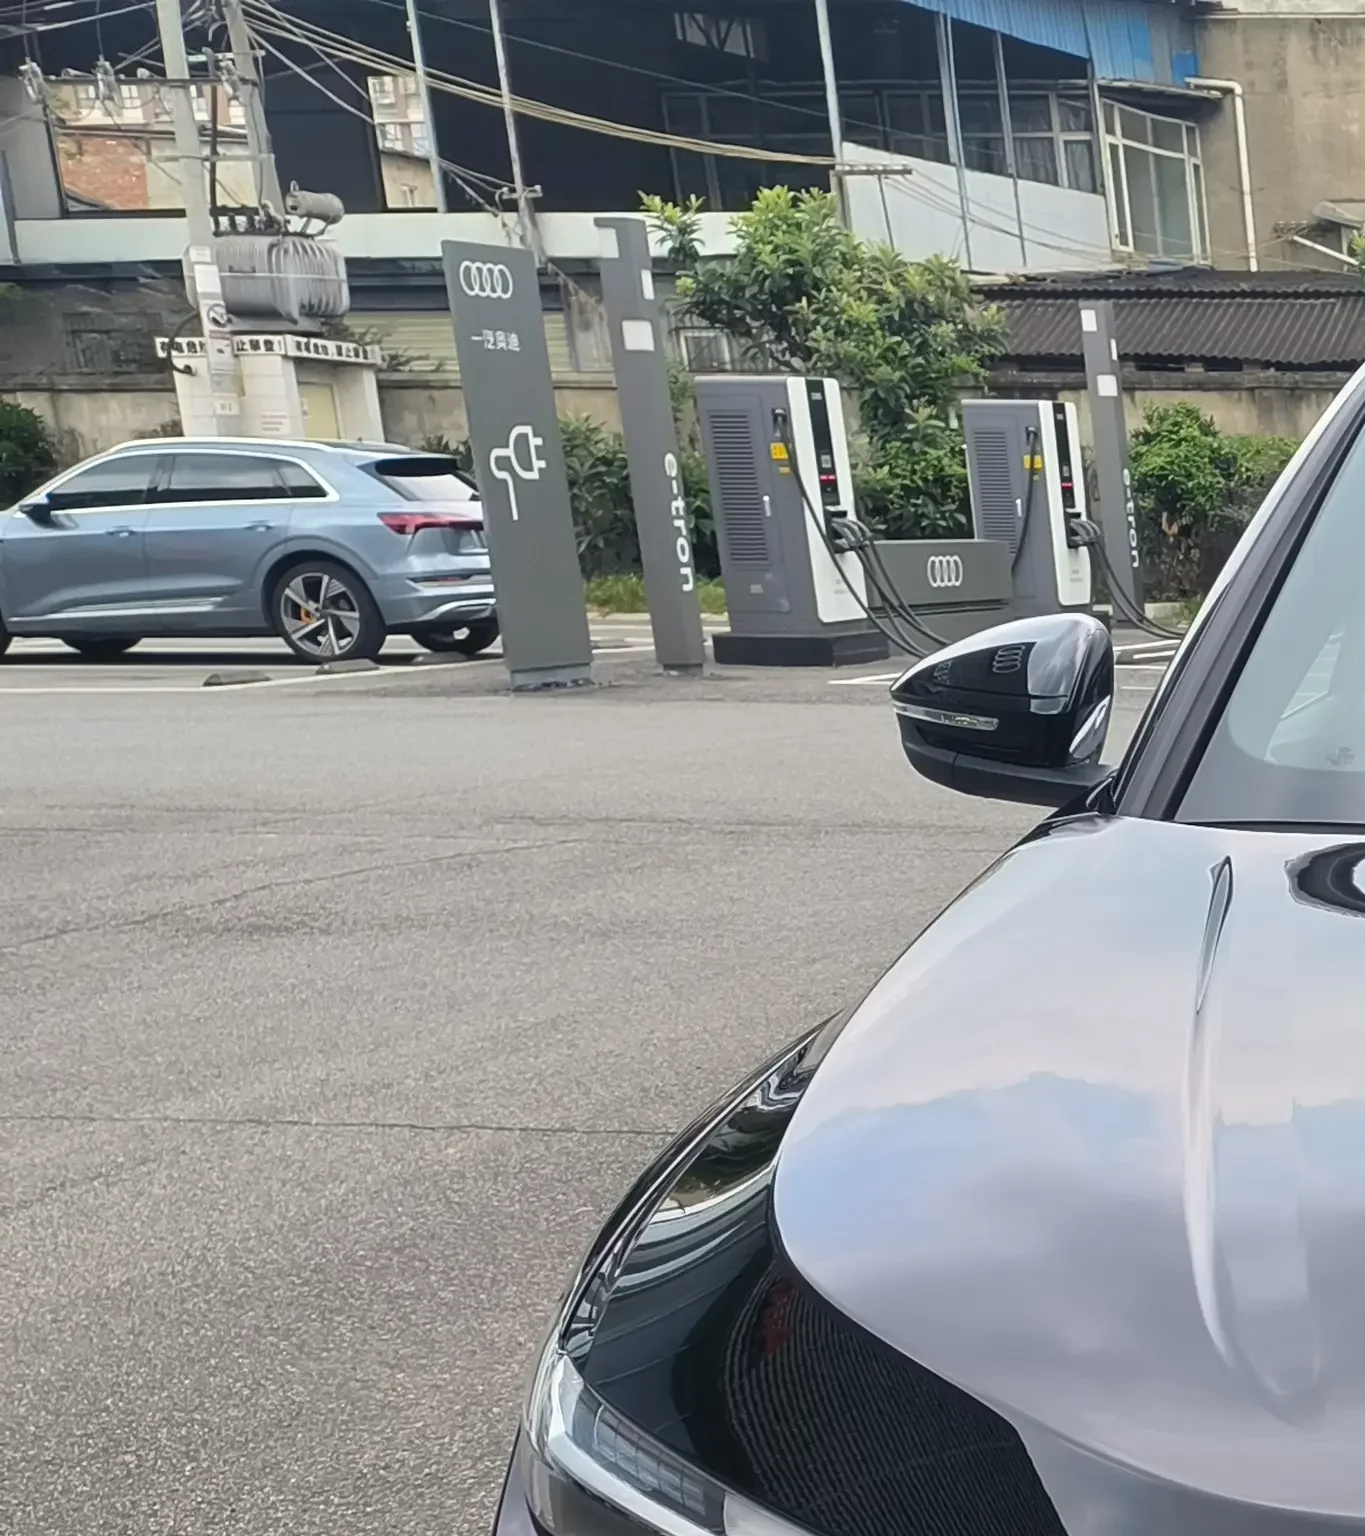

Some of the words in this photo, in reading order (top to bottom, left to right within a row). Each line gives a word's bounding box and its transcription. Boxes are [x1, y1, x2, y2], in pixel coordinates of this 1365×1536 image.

[470, 329, 521, 352] 一汽奥迪
[664, 452, 694, 592] e-tron
[1123, 467, 1139, 568] e-tron
